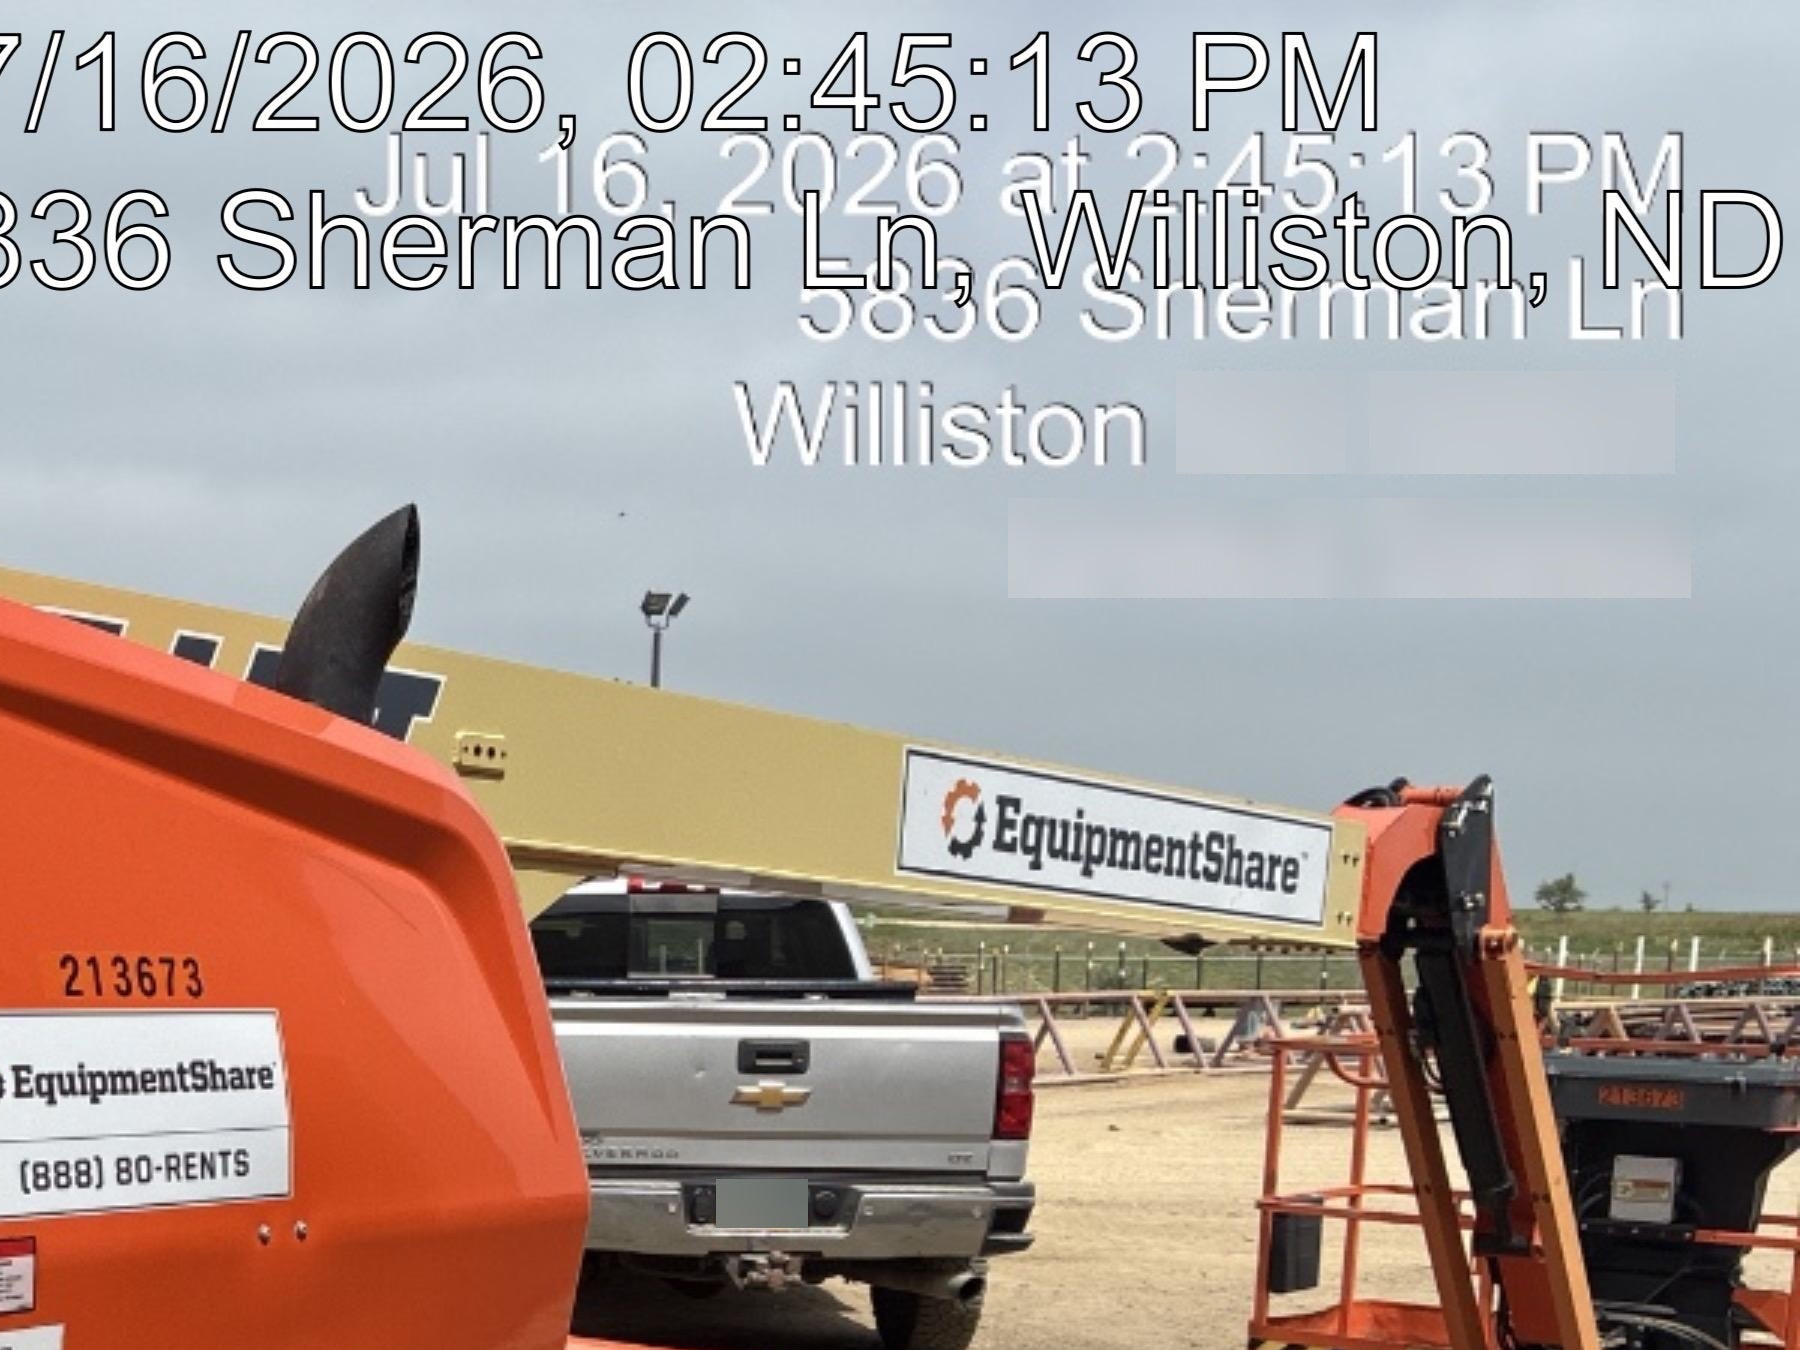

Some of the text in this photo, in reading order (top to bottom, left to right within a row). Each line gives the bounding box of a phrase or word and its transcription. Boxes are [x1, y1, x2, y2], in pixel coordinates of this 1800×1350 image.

[992, 794, 1300, 893] EquipmentShare
[59, 954, 204, 998] 213673
[11, 1058, 275, 1106] EquipmentShare
[19, 1149, 251, 1196] (888) 80-RENTS
